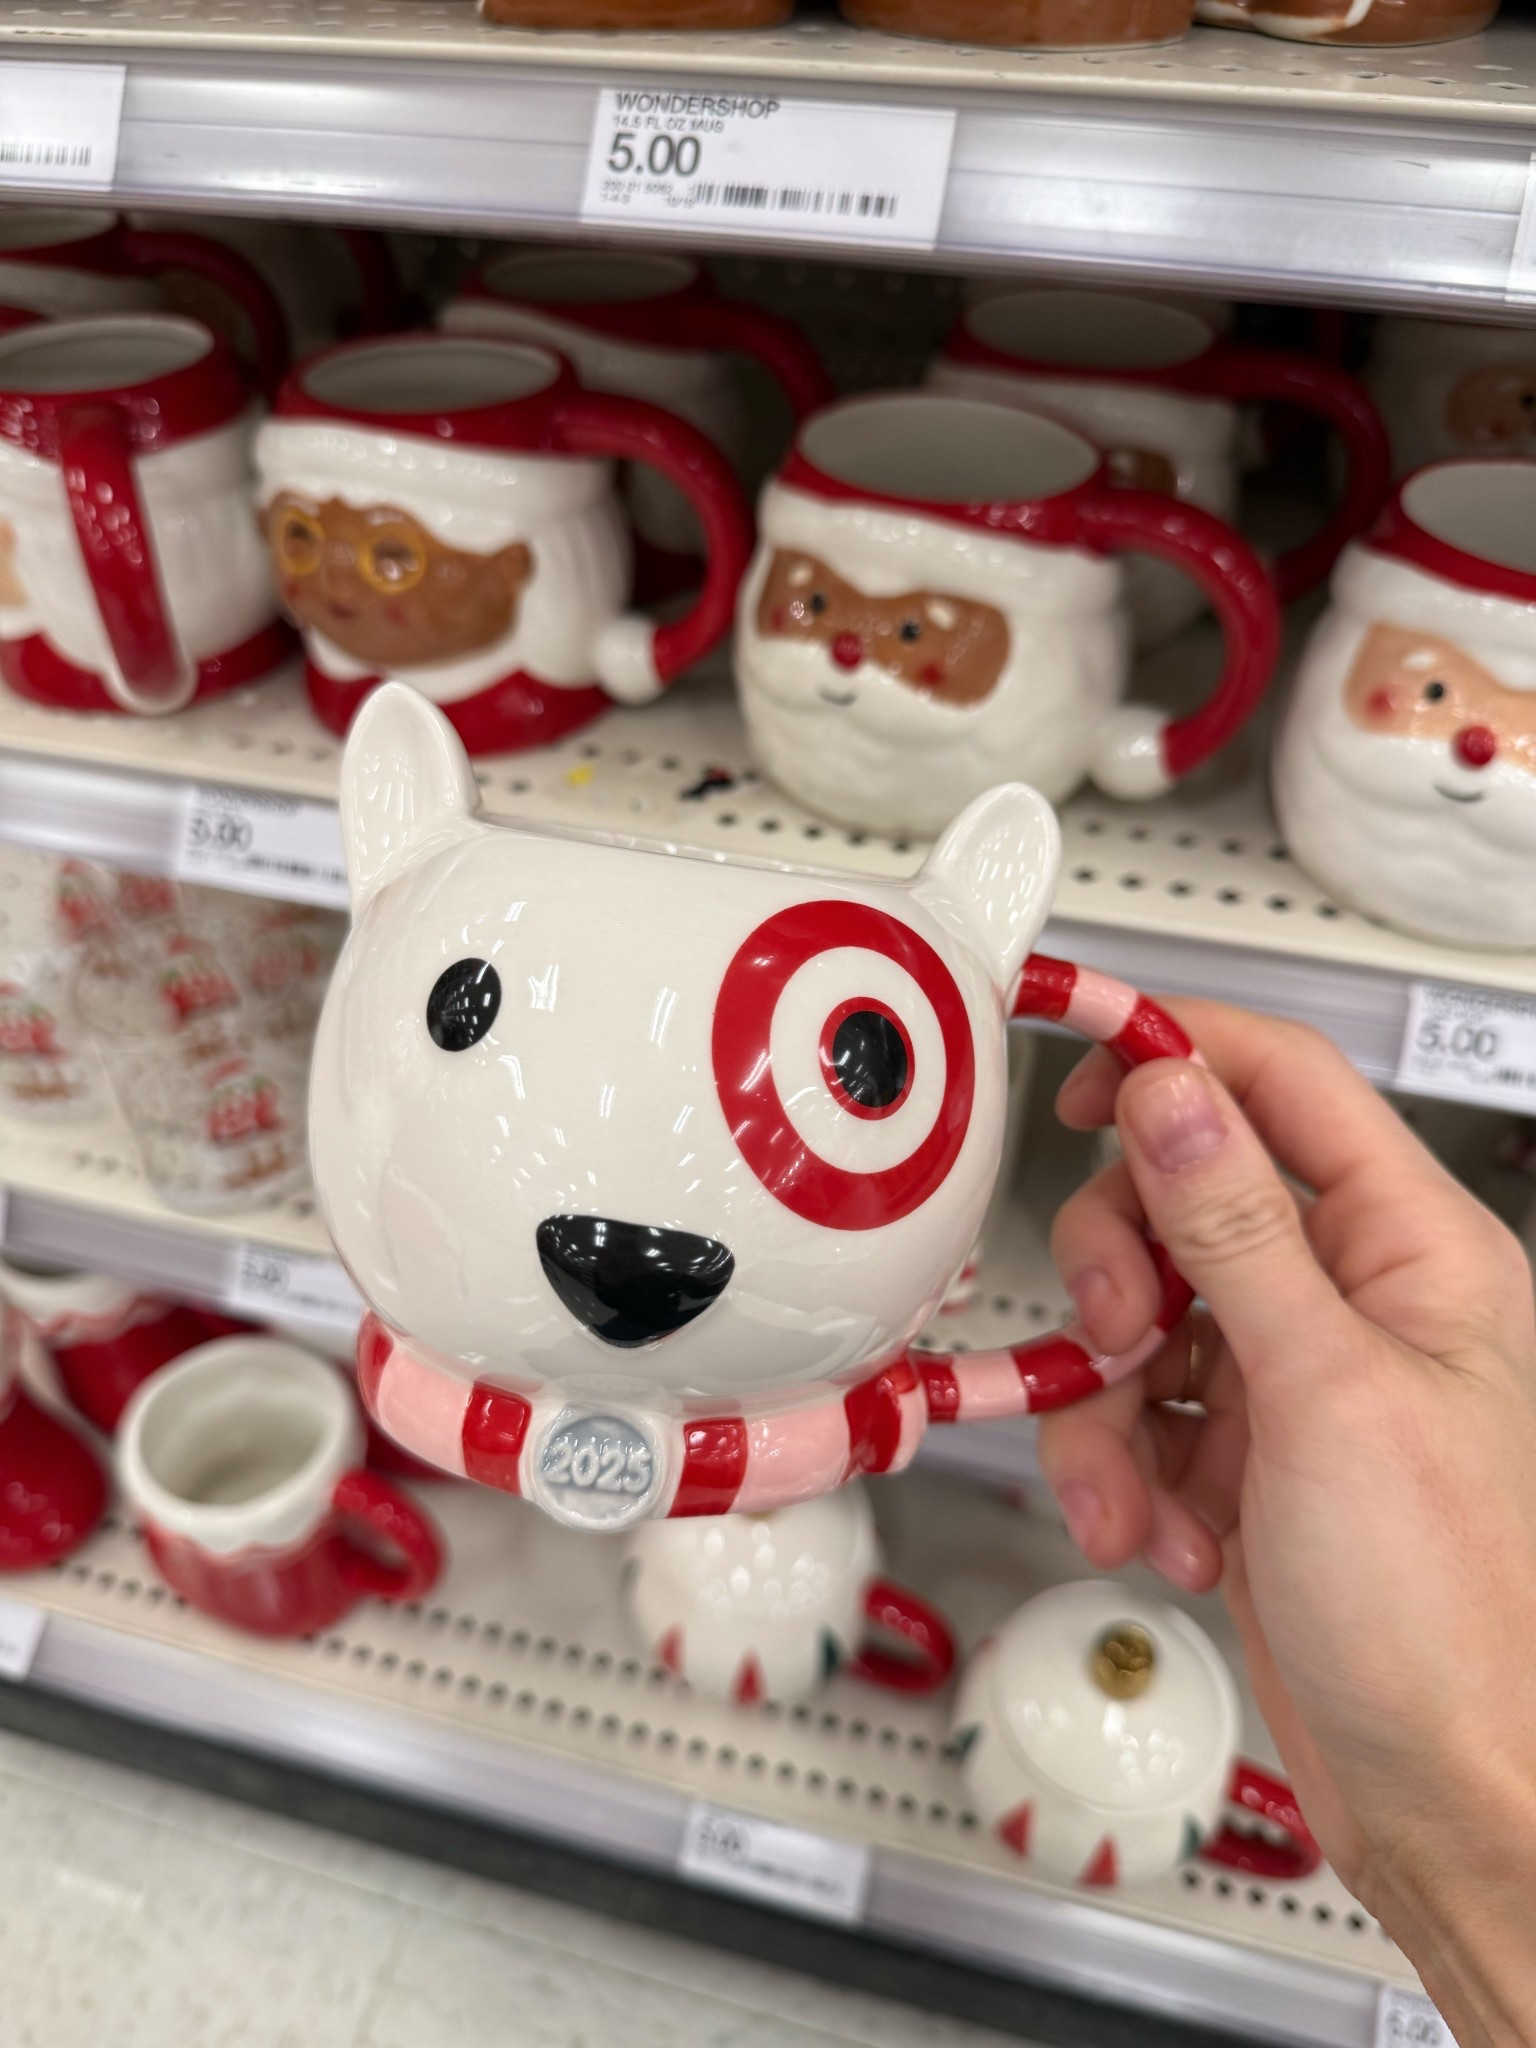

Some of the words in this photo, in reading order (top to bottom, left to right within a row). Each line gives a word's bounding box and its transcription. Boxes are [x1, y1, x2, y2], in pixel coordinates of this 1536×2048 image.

[615, 92, 779, 119] WONDERSHOP
[645, 117, 661, 130] FL
[666, 119, 688, 132] OZ
[608, 131, 702, 177] 5.00
[1417, 1019, 1499, 1061] 5.00
[544, 1439, 651, 1493] 2025
